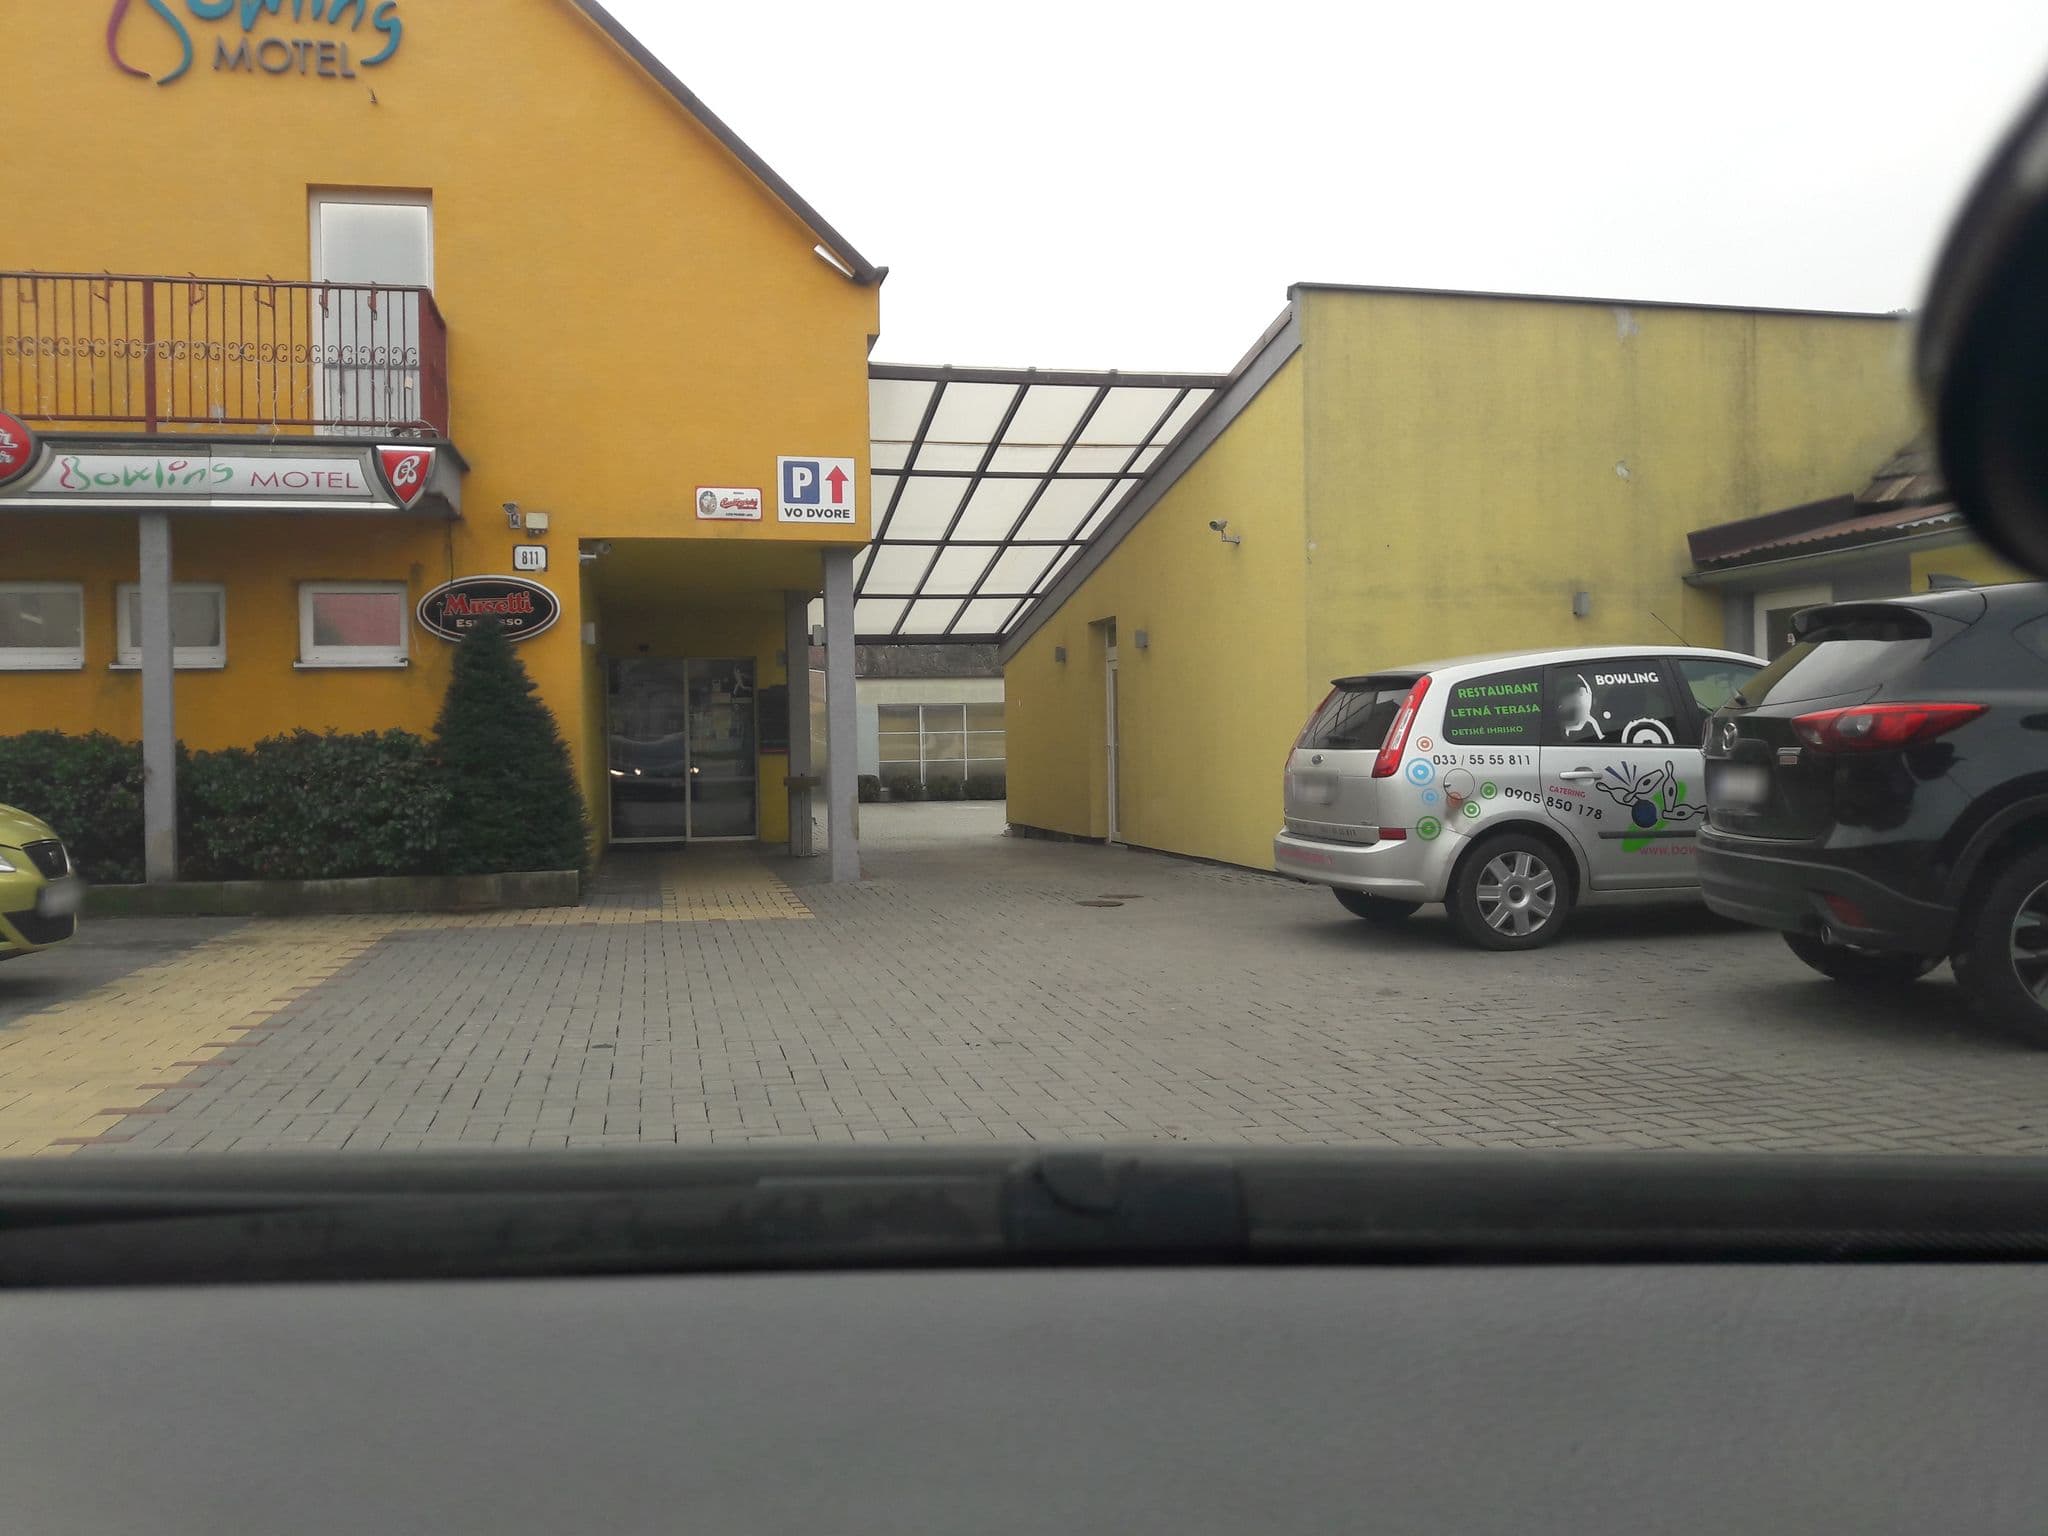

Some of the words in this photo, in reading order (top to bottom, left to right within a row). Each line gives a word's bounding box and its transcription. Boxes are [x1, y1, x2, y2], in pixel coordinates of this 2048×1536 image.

[213, 36, 357, 79] MOTEL
[250, 471, 360, 489] MOTEL
[792, 466, 813, 498] P
[784, 507, 803, 518] VO
[806, 507, 851, 519] DVORE
[521, 550, 539, 565] 811
[443, 591, 534, 616] Musetti
[1595, 672, 1659, 686] BOWLING
[1458, 682, 1539, 699] RESTAURANT
[1451, 703, 1491, 718] LETNÁ
[1493, 703, 1541, 716] TERASA
[1433, 754, 1457, 765] 033
[1469, 754, 1485, 765] 55
[1489, 754, 1505, 765] 55
[1509, 754, 1531, 765] 811
[1549, 784, 1586, 799] CATERING
[1504, 787, 1542, 804] 0905
[1546, 796, 1573, 812] 850
[1577, 804, 1603, 820] 178
